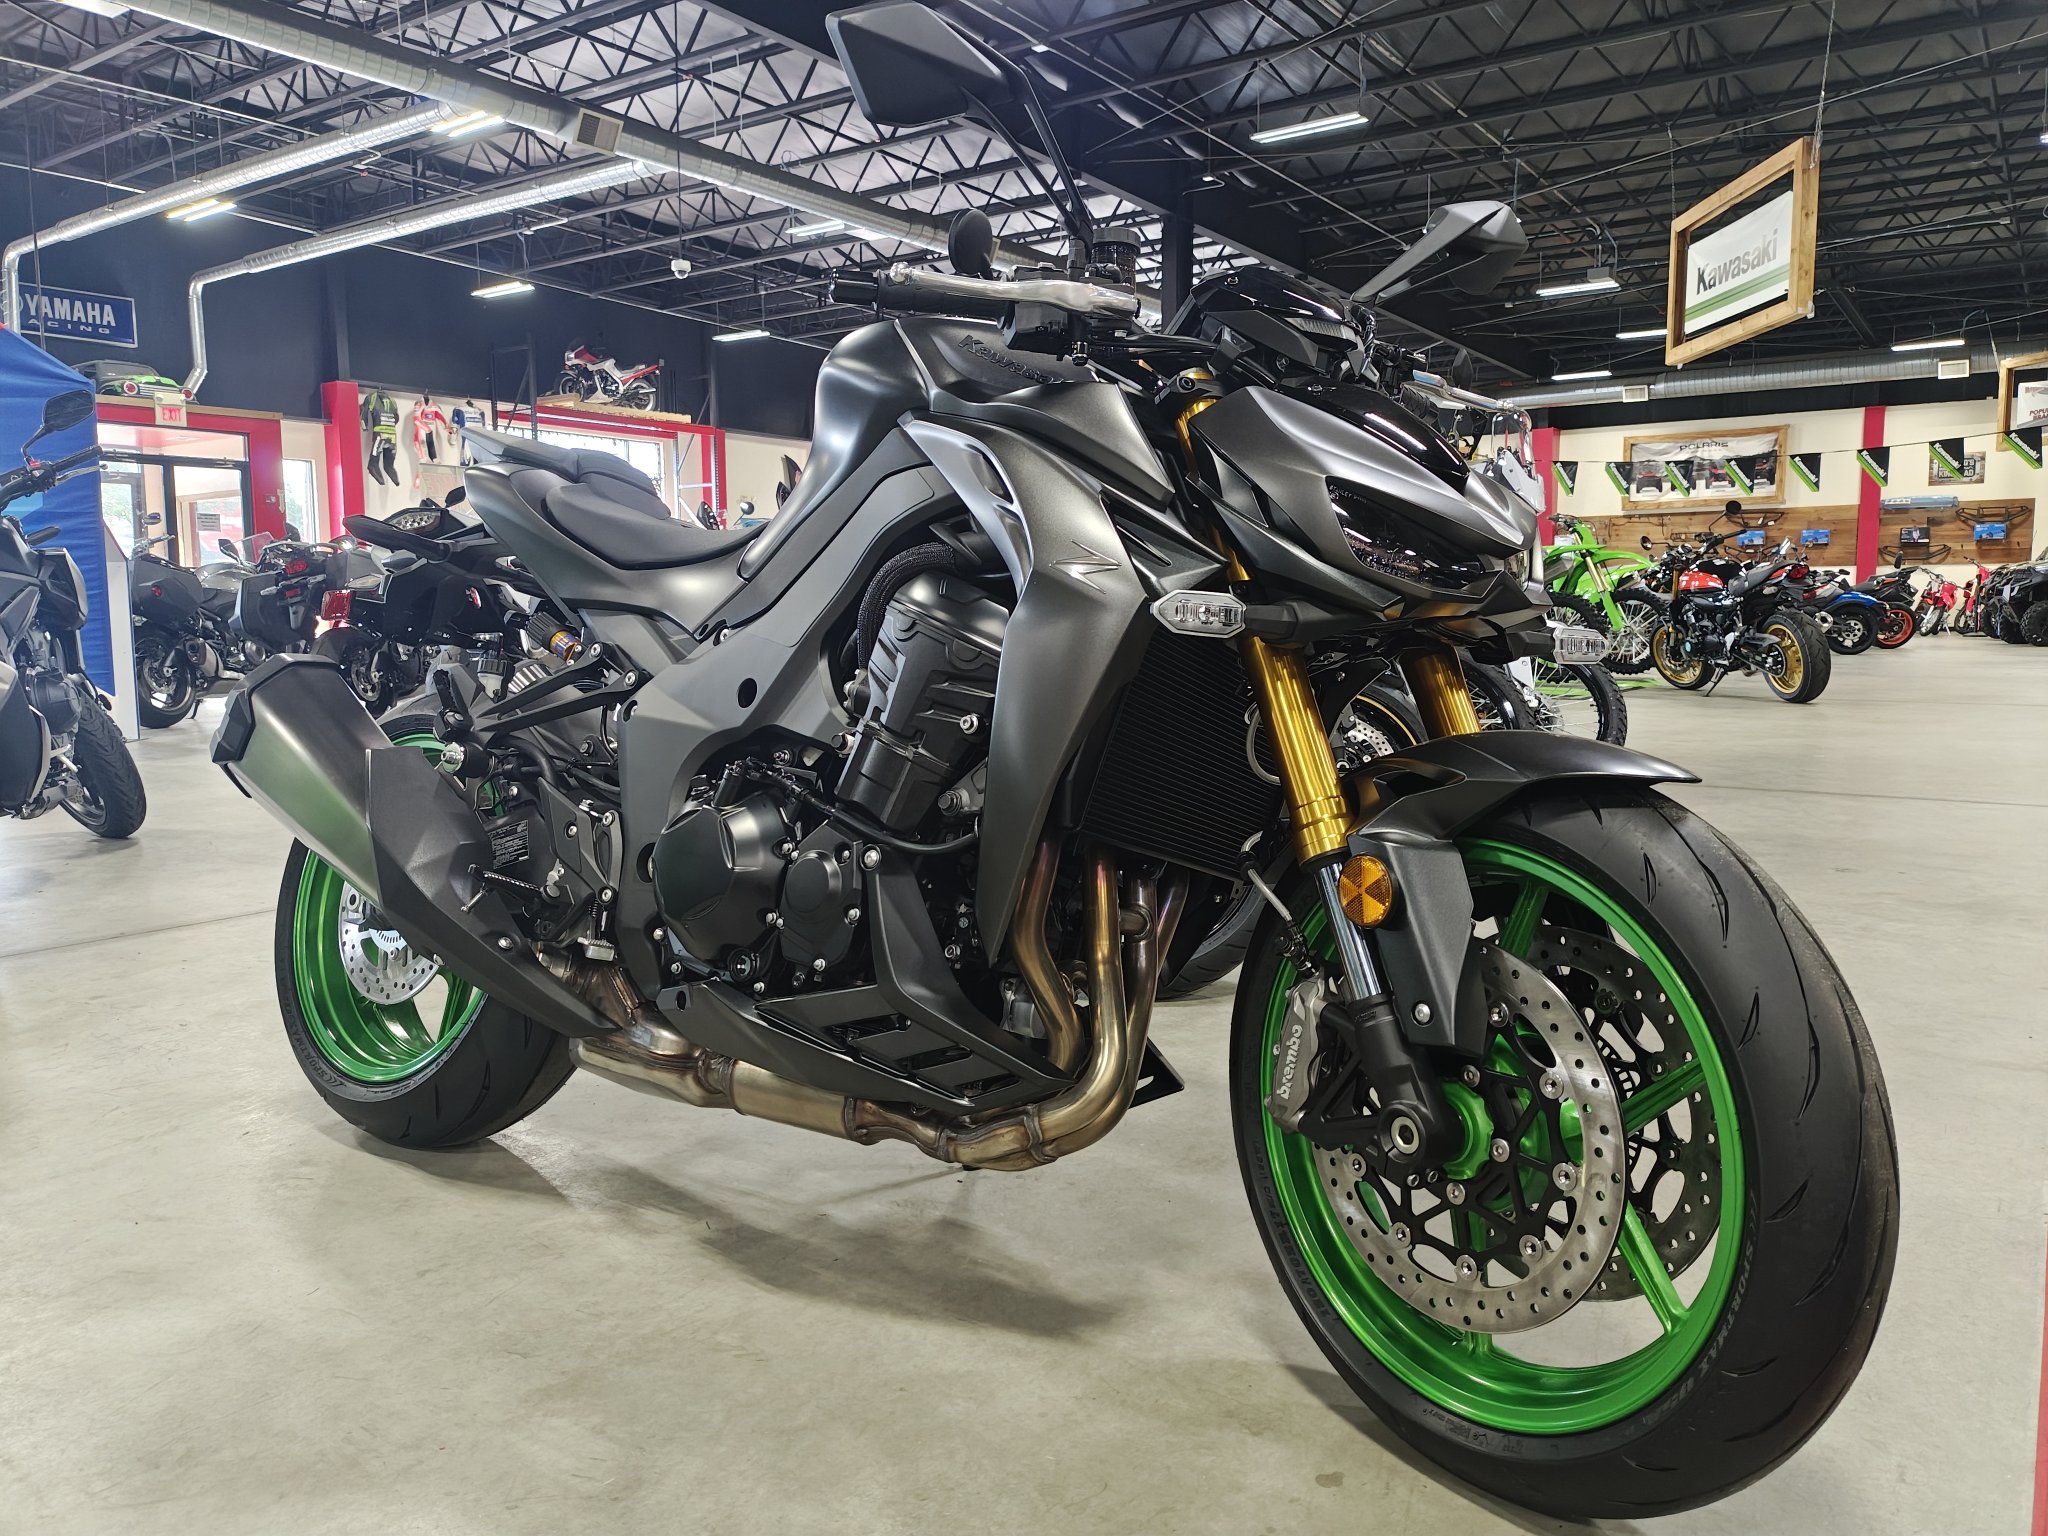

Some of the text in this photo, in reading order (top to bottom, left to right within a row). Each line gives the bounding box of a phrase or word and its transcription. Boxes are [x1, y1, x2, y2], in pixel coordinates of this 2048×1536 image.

[1696, 228, 1778, 295] Kawasaki
[25, 293, 116, 327] YAMAHA
[28, 318, 110, 334] ACING
[958, 334, 1064, 384] Kawasa
[161, 407, 183, 422] EXIT
[1679, 441, 1729, 451] POLARIS
[1276, 1024, 1303, 1100] brembo
